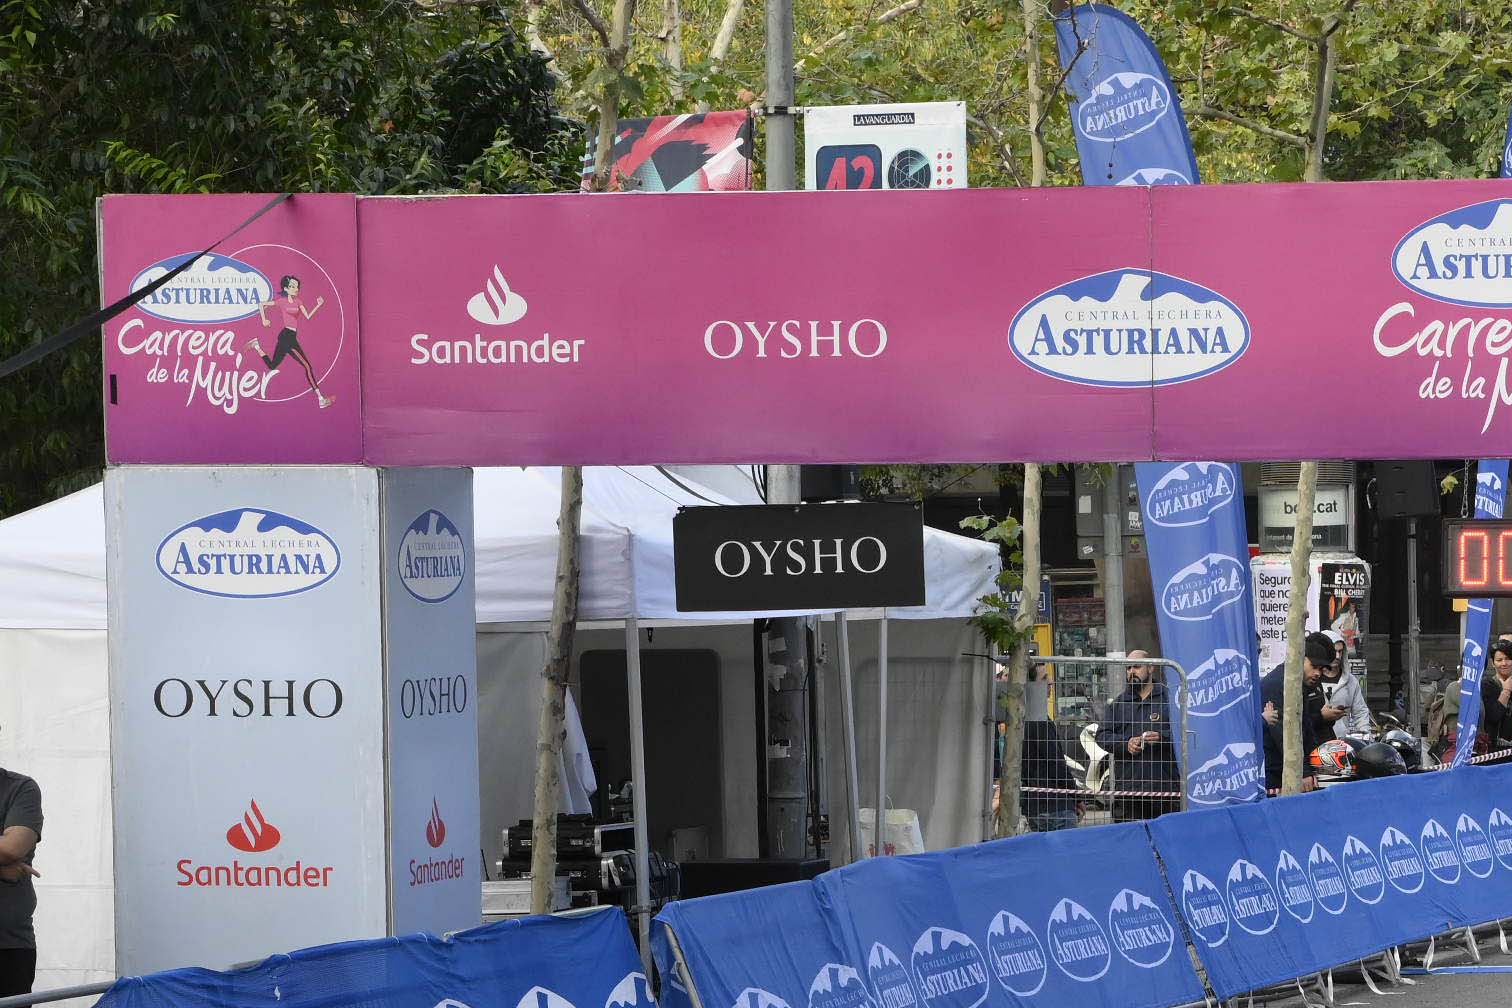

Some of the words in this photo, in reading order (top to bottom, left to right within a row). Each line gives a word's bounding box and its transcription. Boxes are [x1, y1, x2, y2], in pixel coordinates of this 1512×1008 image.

[1065, 311, 1139, 322] CENTRAL
[1147, 309, 1224, 321] LECHERA
[117, 319, 236, 356] Carrera
[410, 332, 585, 365] Santander
[703, 318, 888, 359] OYSHO
[1028, 314, 1232, 356] ASTURIANA
[146, 358, 169, 384] de
[174, 356, 189, 384] la
[186, 352, 280, 415] Mujer
[1419, 360, 1453, 399] de
[1461, 358, 1486, 399] la
[170, 542, 328, 576] ASTURIANA
[198, 539, 255, 549] CENTRAL
[262, 539, 321, 549] LECHERA
[714, 536, 888, 578] OYSHO
[404, 544, 461, 580] ASTURIANA
[1334, 572, 1365, 585] ELVIS
[1260, 588, 1276, 601] que
[1261, 629, 1280, 640] este
[153, 677, 344, 719] OYSHO
[400, 673, 468, 719] OYSHO
[176, 859, 334, 888] Santander
[409, 855, 465, 887] Santander
[992, 945, 1044, 979] ASTURIANA
[1053, 931, 1109, 964] ASTURIANA
[916, 961, 986, 1001] ASTURIANA
